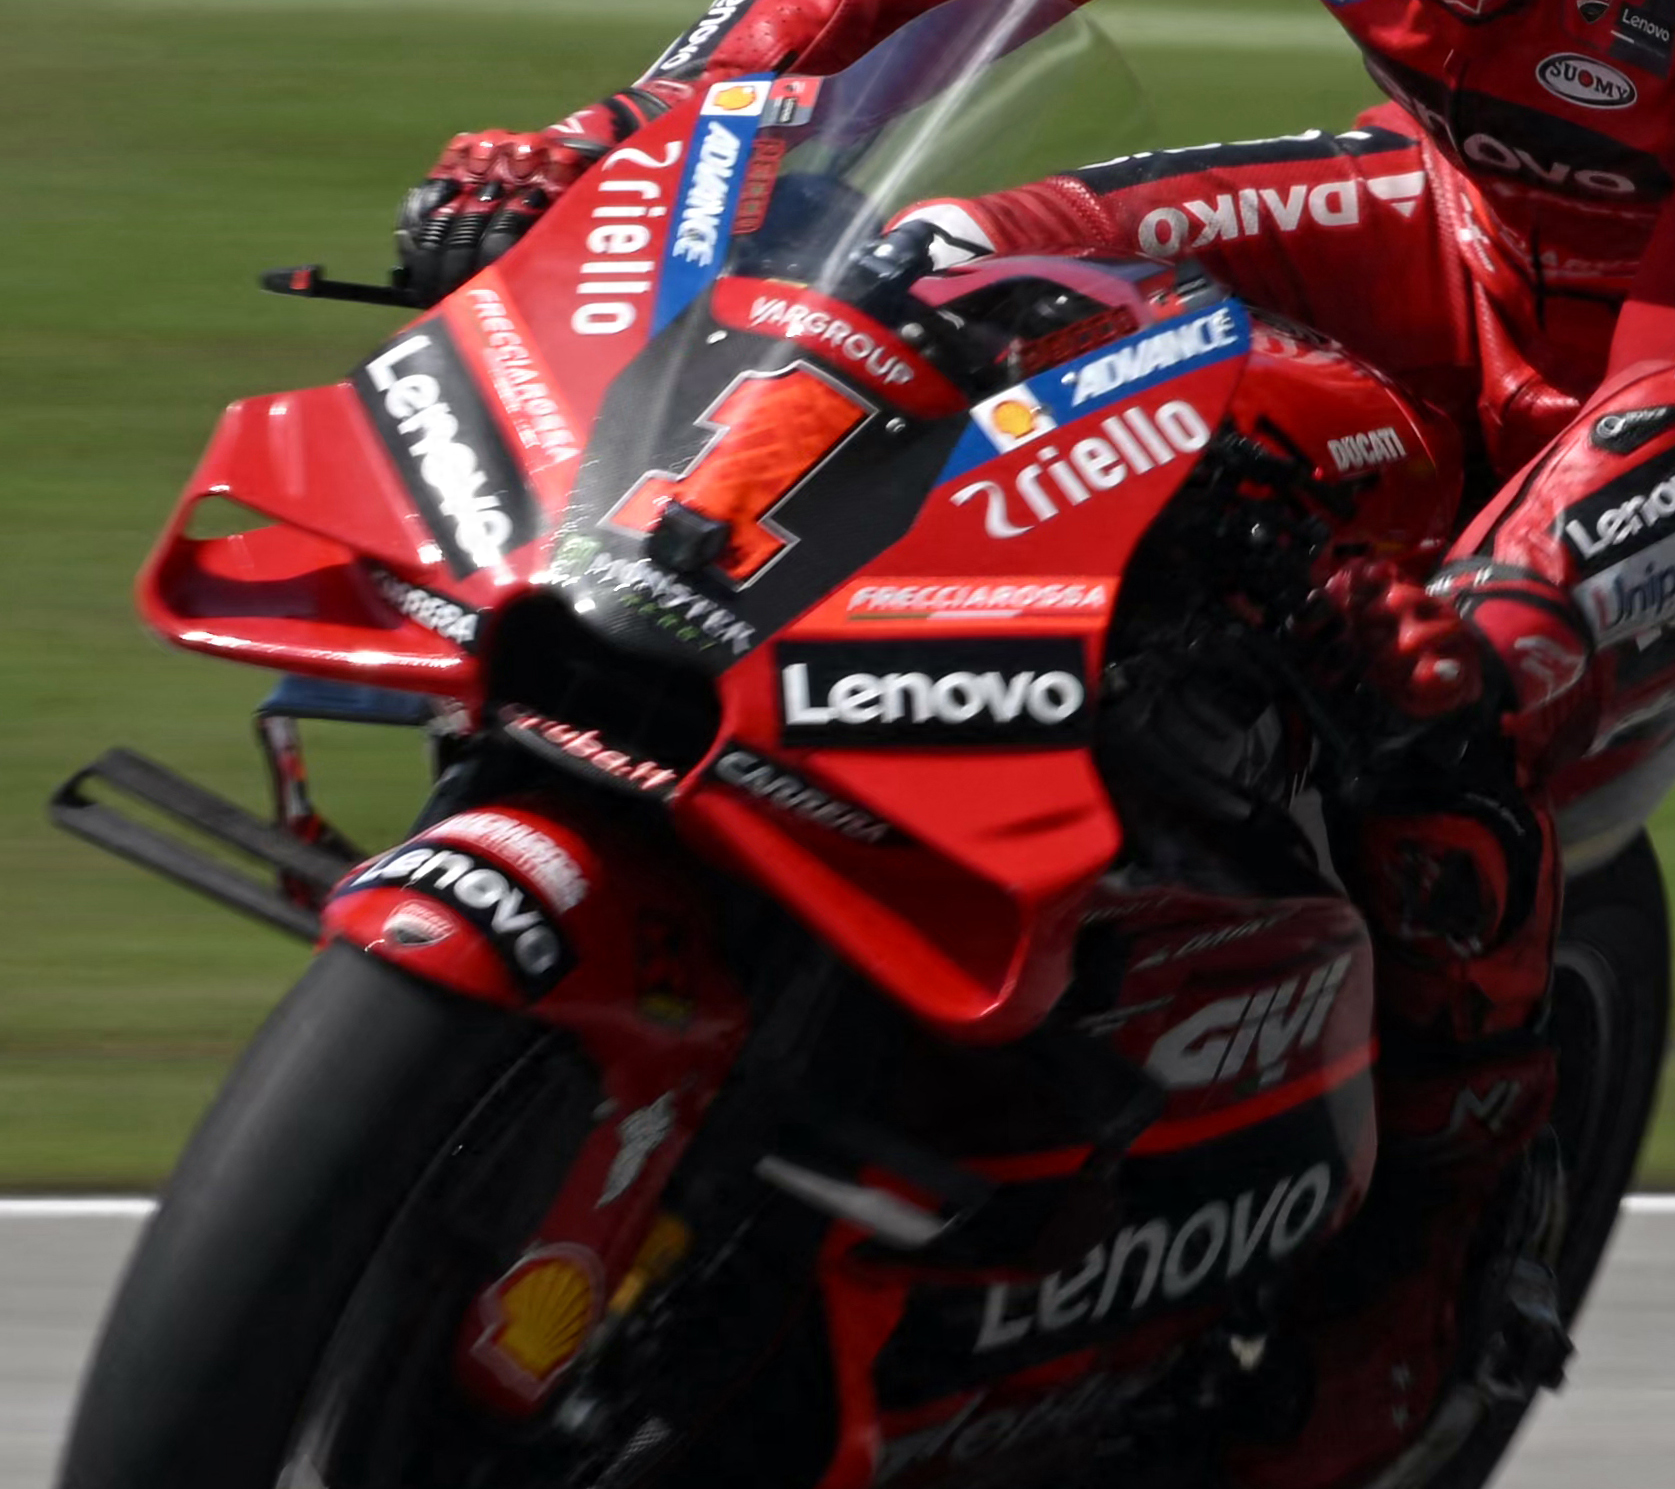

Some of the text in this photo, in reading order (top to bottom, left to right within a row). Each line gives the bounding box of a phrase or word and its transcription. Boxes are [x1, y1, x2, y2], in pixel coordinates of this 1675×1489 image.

[1622, 7, 1670, 43] Lenovo
[1549, 60, 1631, 100] SUOMY
[570, 179, 668, 335] riello
[1137, 179, 1360, 258] DAIKO
[1072, 306, 1239, 407] ADVANCE
[365, 334, 514, 569] Lenovo
[597, 358, 879, 592] 1
[1015, 398, 1212, 523] riello
[1326, 426, 1407, 472] DUCATI
[848, 583, 1108, 611] FRECCIAROSSA
[781, 661, 1085, 726] Lenovo
[348, 847, 561, 977] Lenovo
